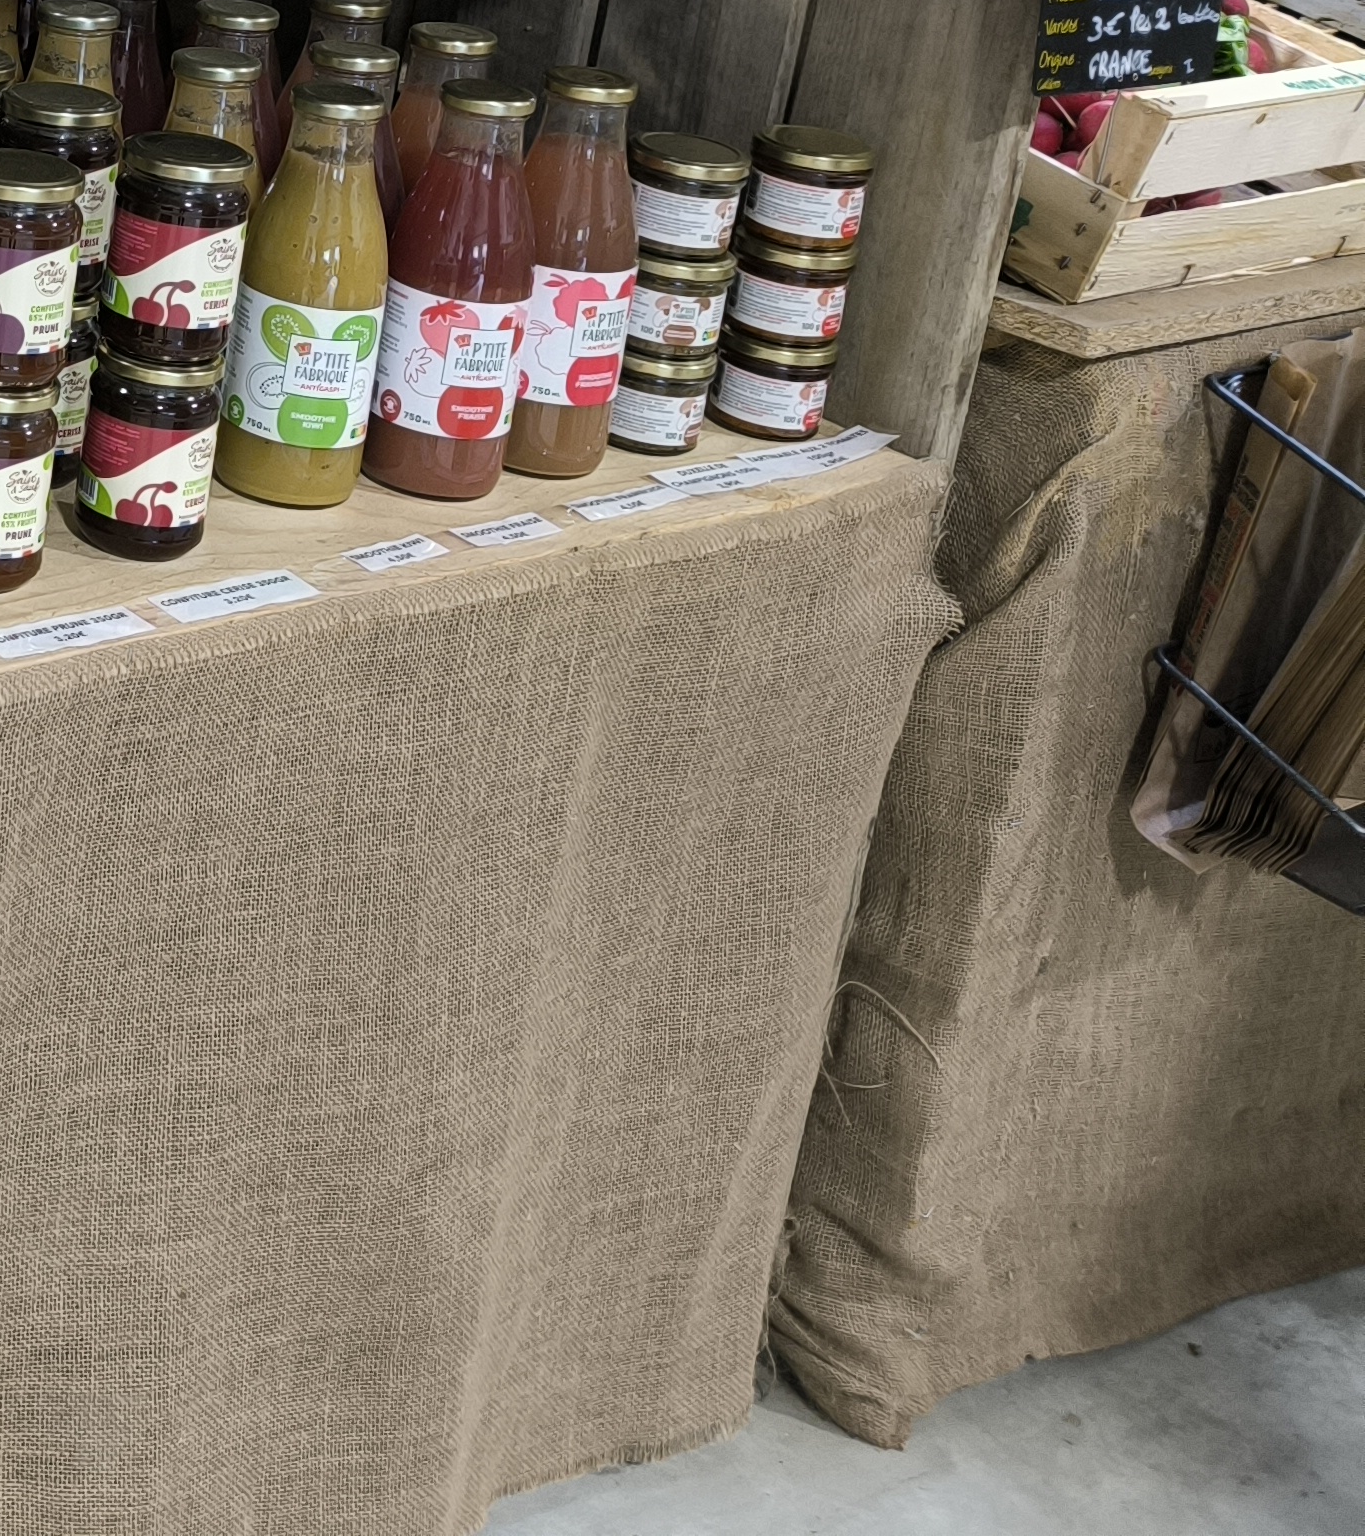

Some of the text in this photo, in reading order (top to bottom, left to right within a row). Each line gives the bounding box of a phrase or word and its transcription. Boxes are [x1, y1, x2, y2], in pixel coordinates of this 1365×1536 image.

[1154, 8, 1171, 29] 2
[33, 323, 59, 334] PRUNE
[295, 366, 348, 384] FABRIQUE
[455, 359, 503, 372] FABRIQUE
[160, 590, 220, 608] CONFITURE
[221, 581, 257, 596] CERISE
[53, 618, 90, 632] PRUNE
[90, 611, 128, 624] 350GR
